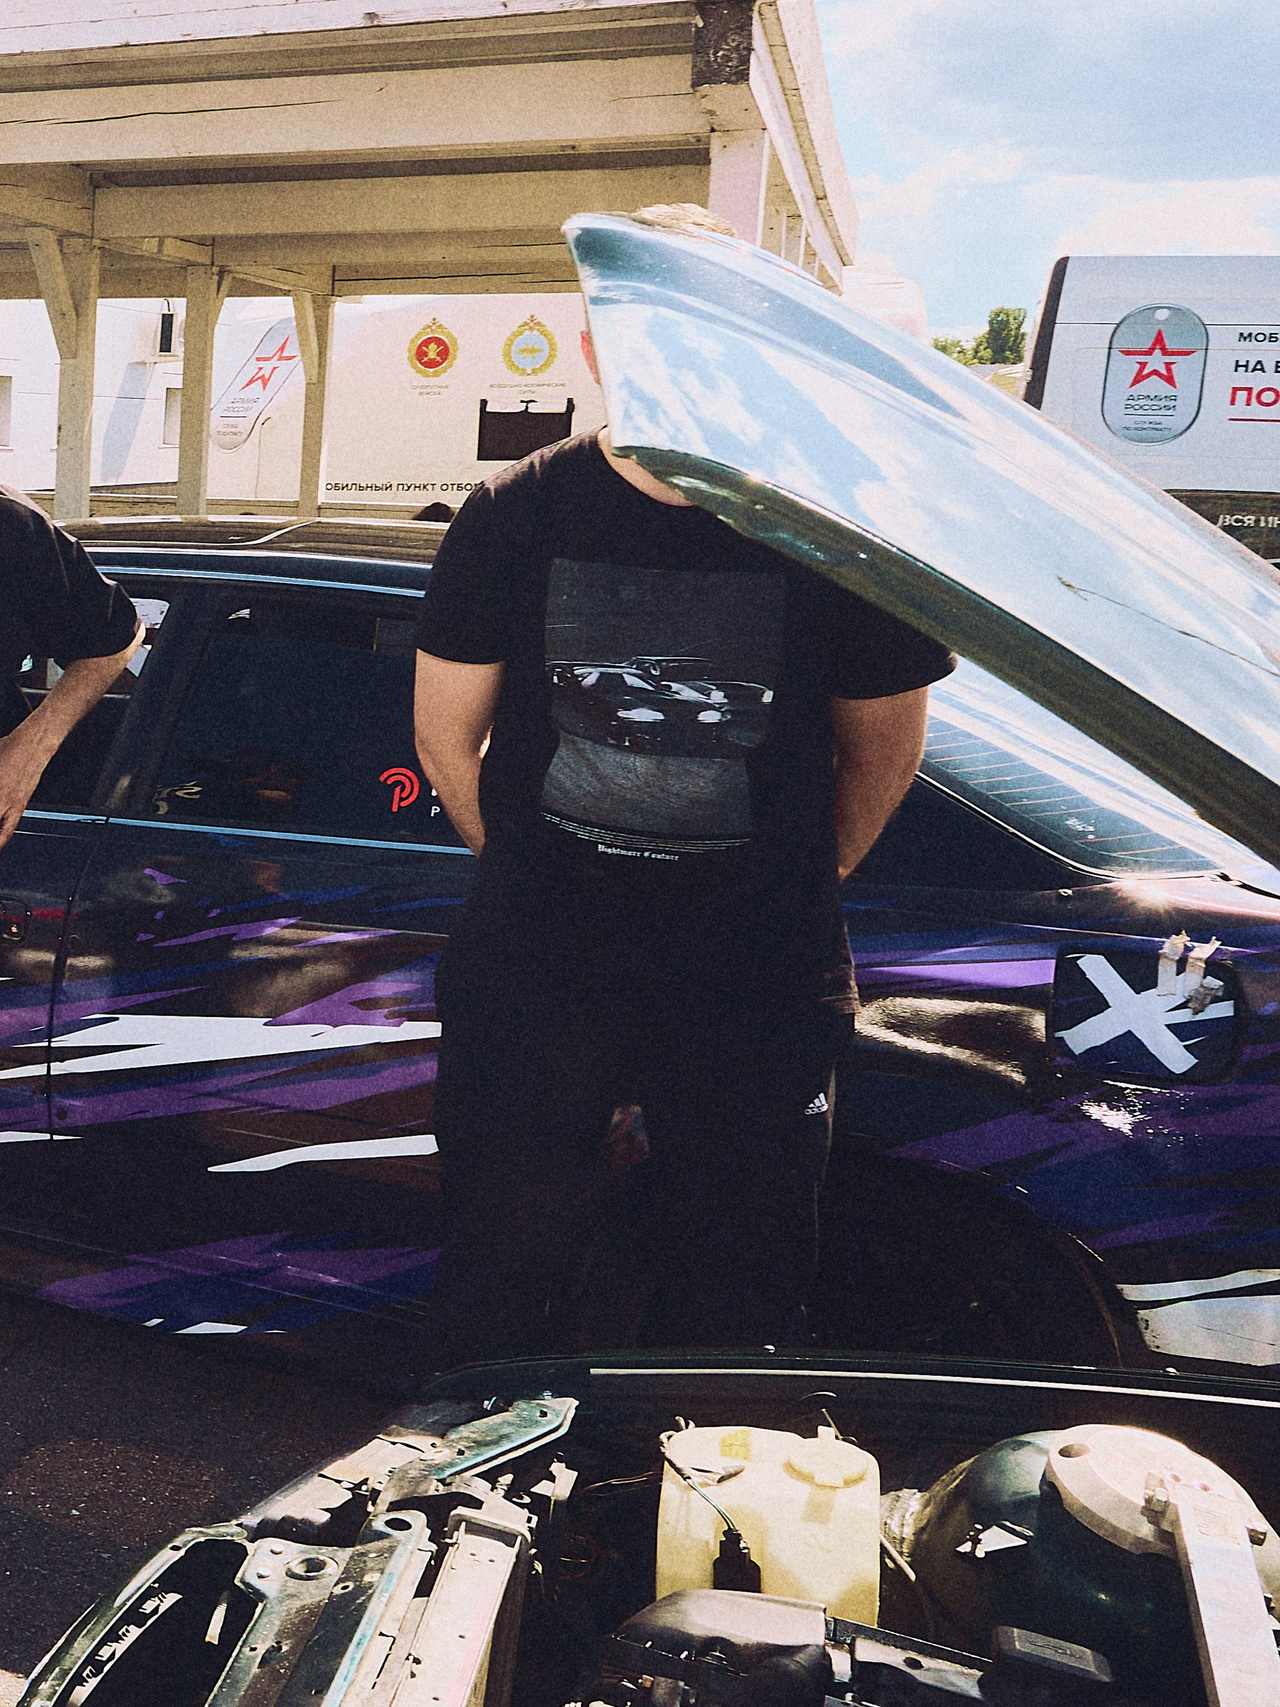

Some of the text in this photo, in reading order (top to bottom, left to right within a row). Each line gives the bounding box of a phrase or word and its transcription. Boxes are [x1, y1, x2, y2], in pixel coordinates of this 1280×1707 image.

[1233, 360, 1266, 373] НА
[1124, 403, 1177, 412] РОССИИ
[325, 481, 393, 492] ОБИЛЬНЫЙ
[397, 483, 437, 492] ПУНКТ
